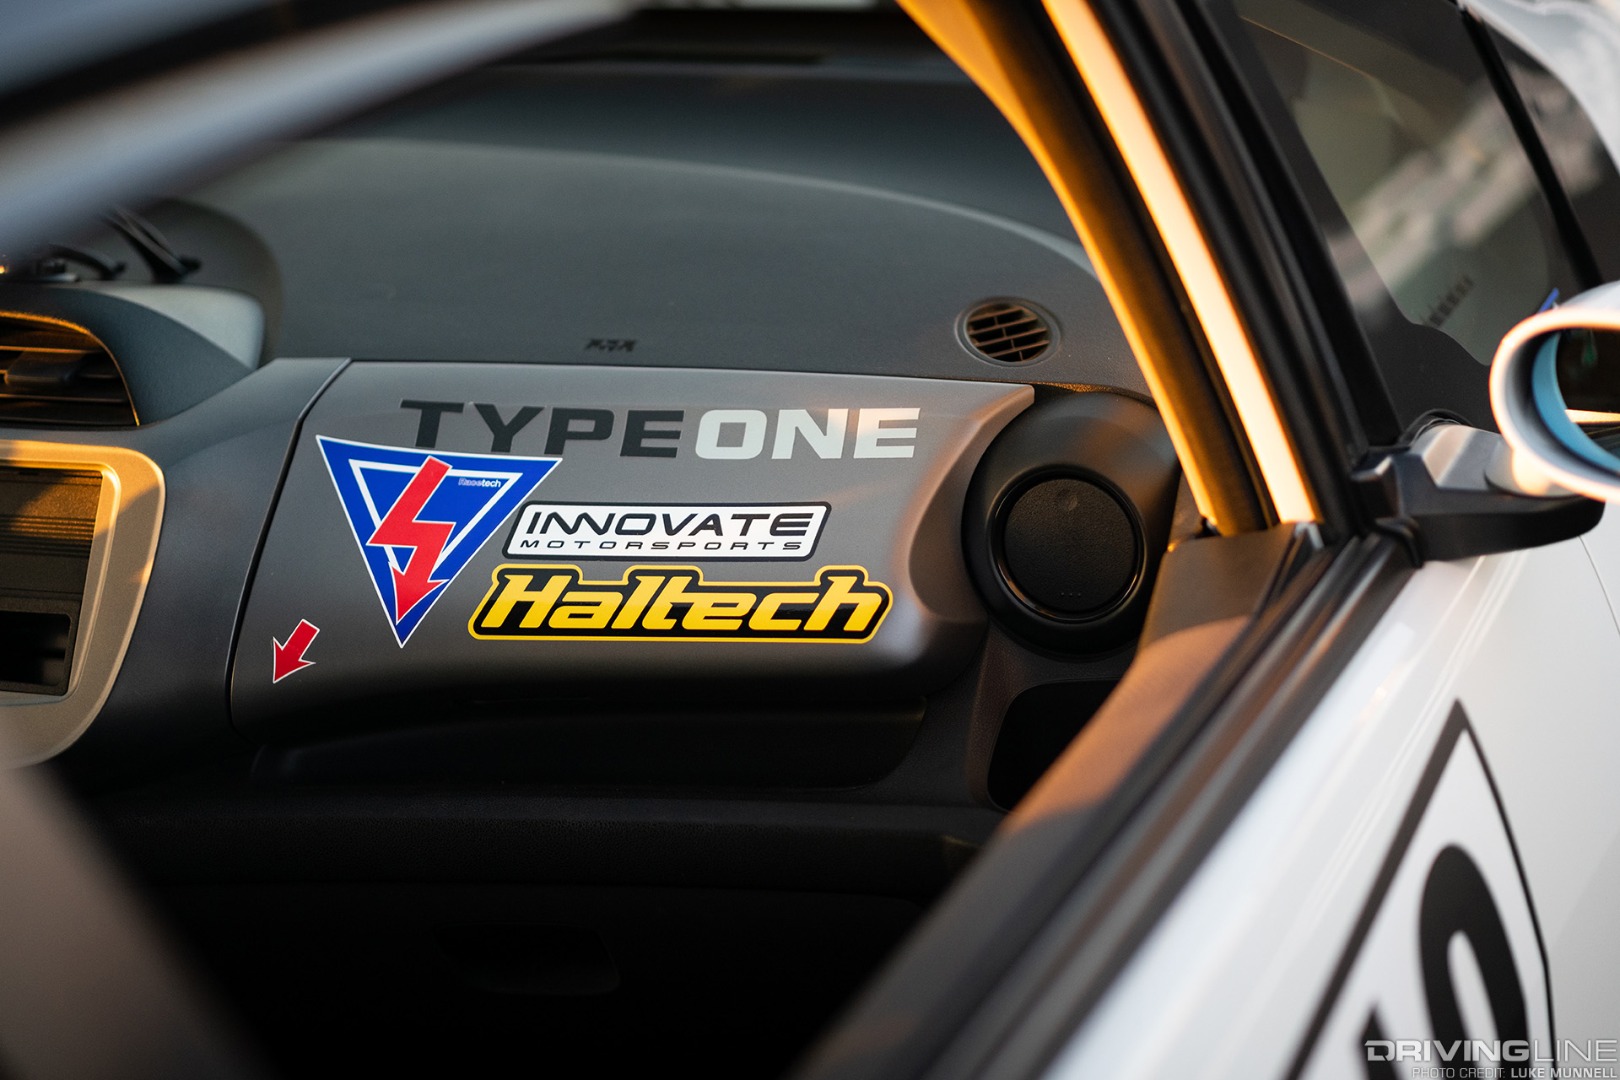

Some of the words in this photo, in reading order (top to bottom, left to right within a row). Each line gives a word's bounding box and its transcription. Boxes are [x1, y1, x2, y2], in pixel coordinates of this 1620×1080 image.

[526, 510, 811, 537] INNOVATE
[520, 539, 802, 550] MOTORSPORTS
[480, 573, 884, 632] Haltech
